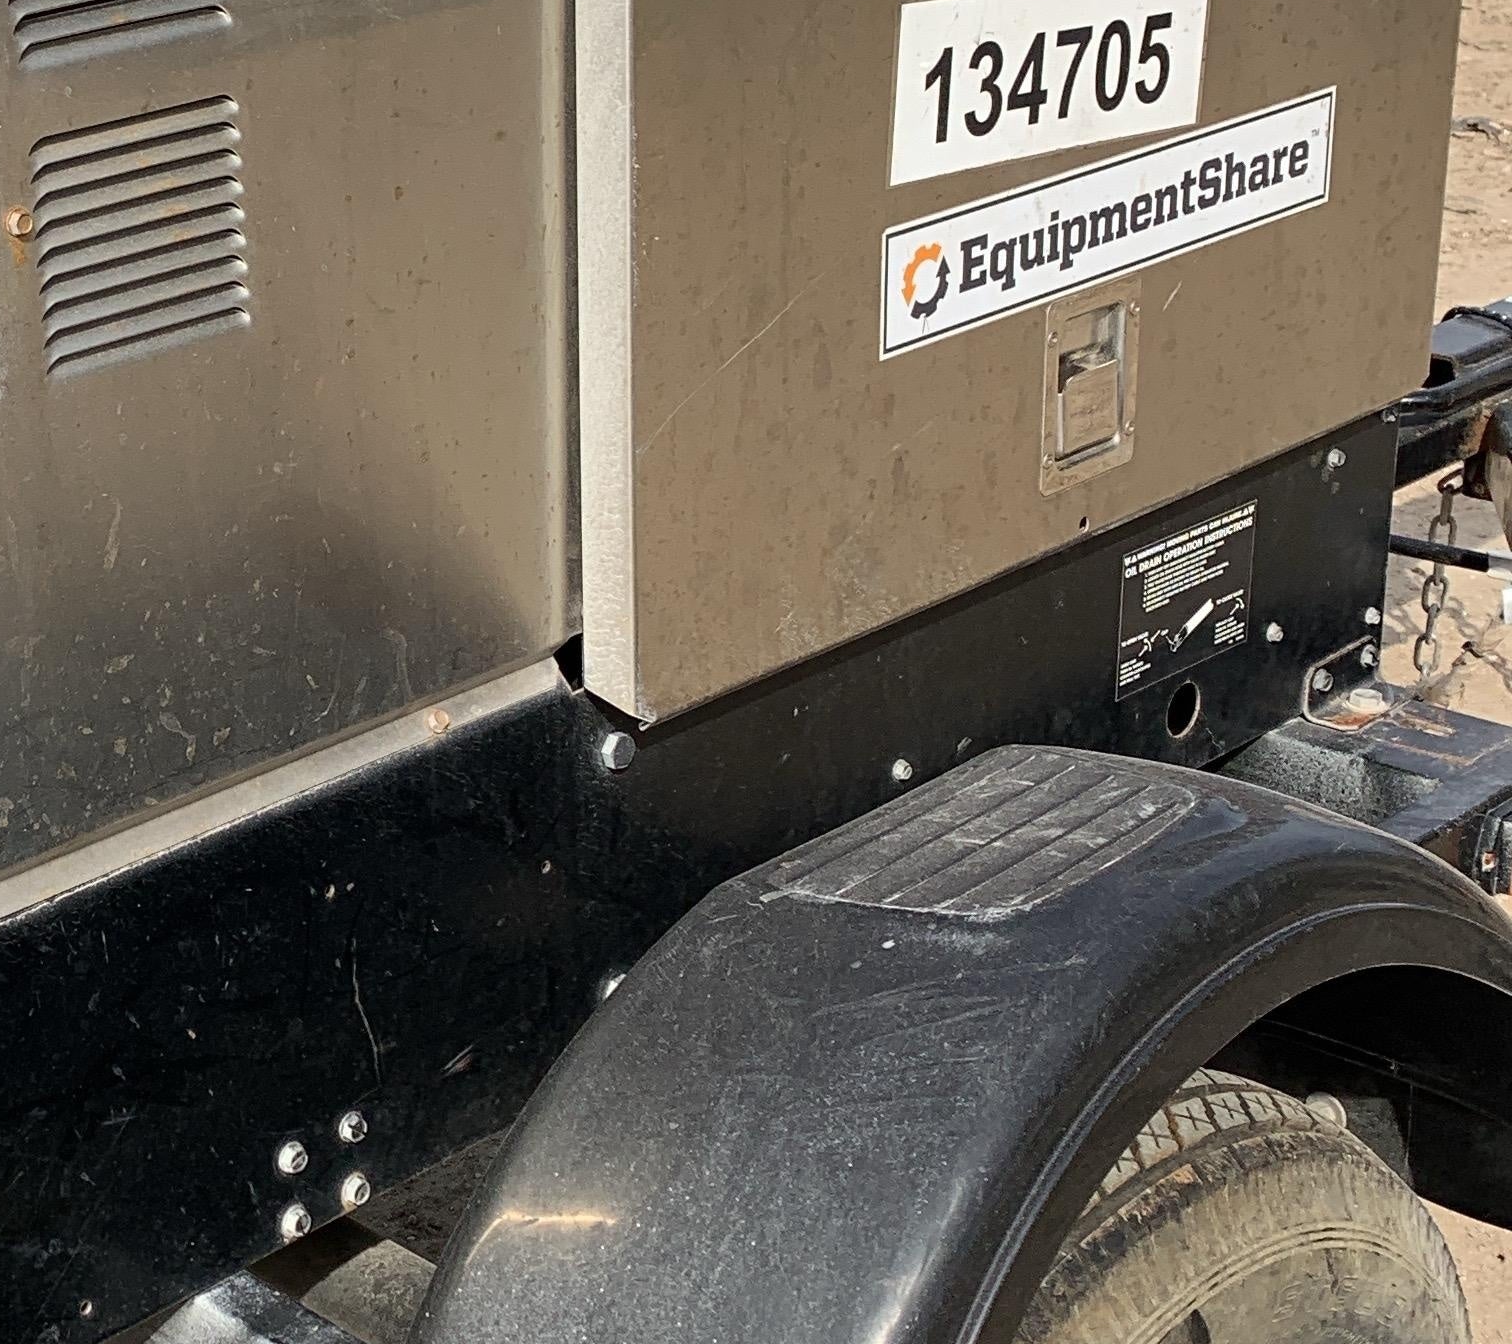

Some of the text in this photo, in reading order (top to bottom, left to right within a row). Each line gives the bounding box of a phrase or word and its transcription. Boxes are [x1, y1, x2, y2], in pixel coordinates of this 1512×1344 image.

[924, 10, 1174, 145] 134705
[959, 136, 1312, 294] EquipmentShare
[1138, 553, 1162, 573] DRAIN
[1162, 536, 1203, 563] OPERATION
[1203, 515, 1253, 546] INSTRUCTIONS
